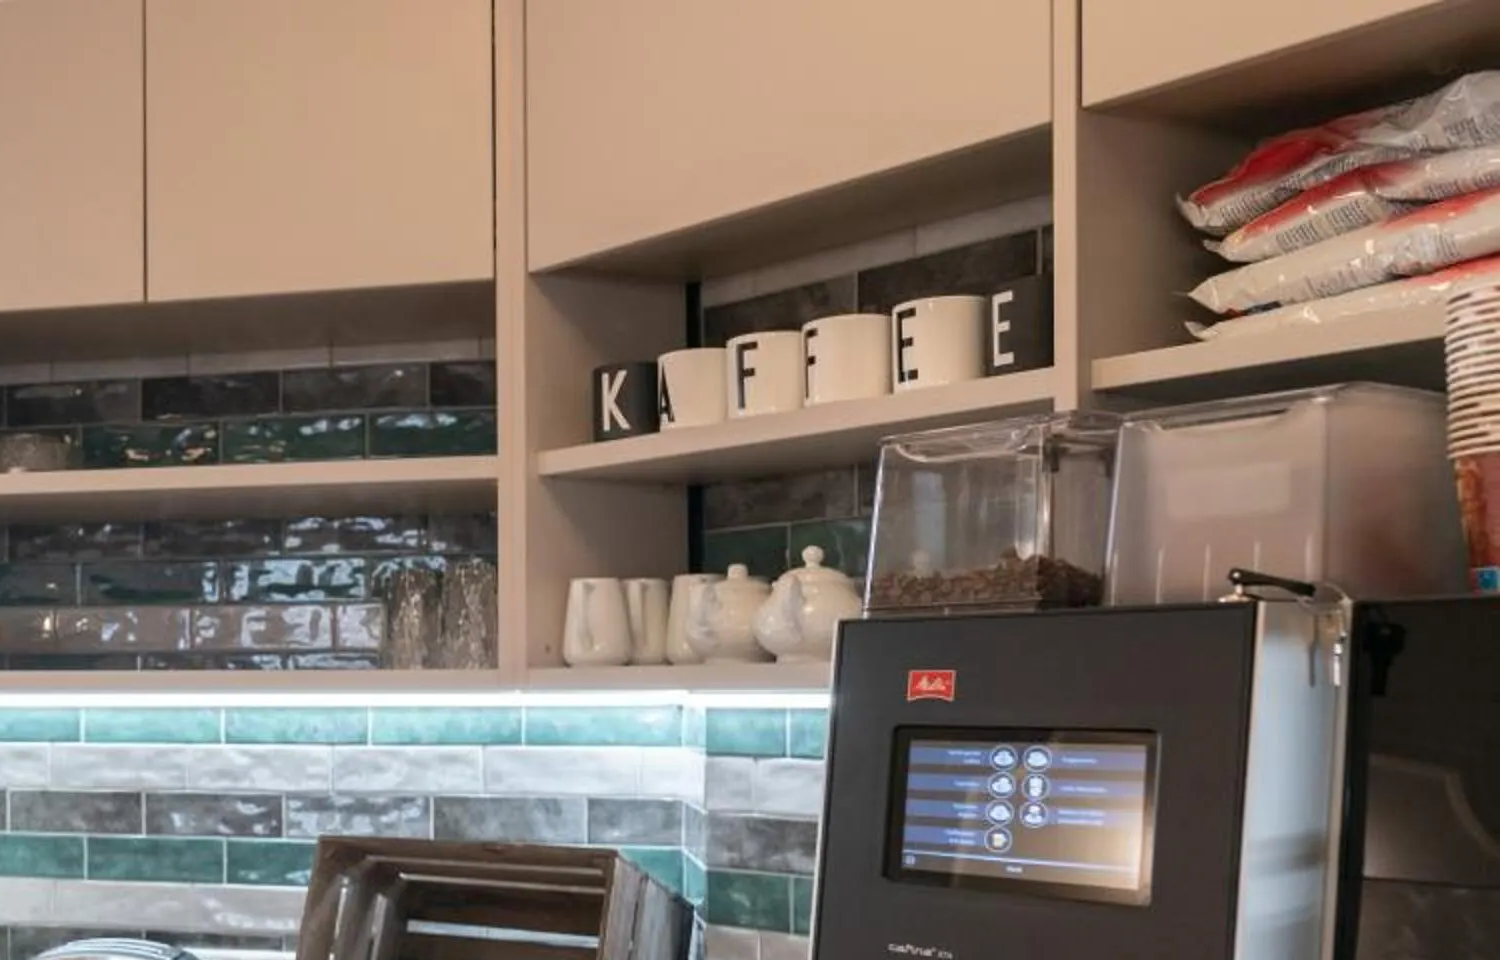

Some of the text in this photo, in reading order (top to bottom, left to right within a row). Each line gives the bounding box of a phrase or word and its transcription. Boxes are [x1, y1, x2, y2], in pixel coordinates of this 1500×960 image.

[600, 369, 630, 431] K
[736, 341, 759, 410] F
[896, 307, 919, 384] E
[991, 290, 1015, 368] E
